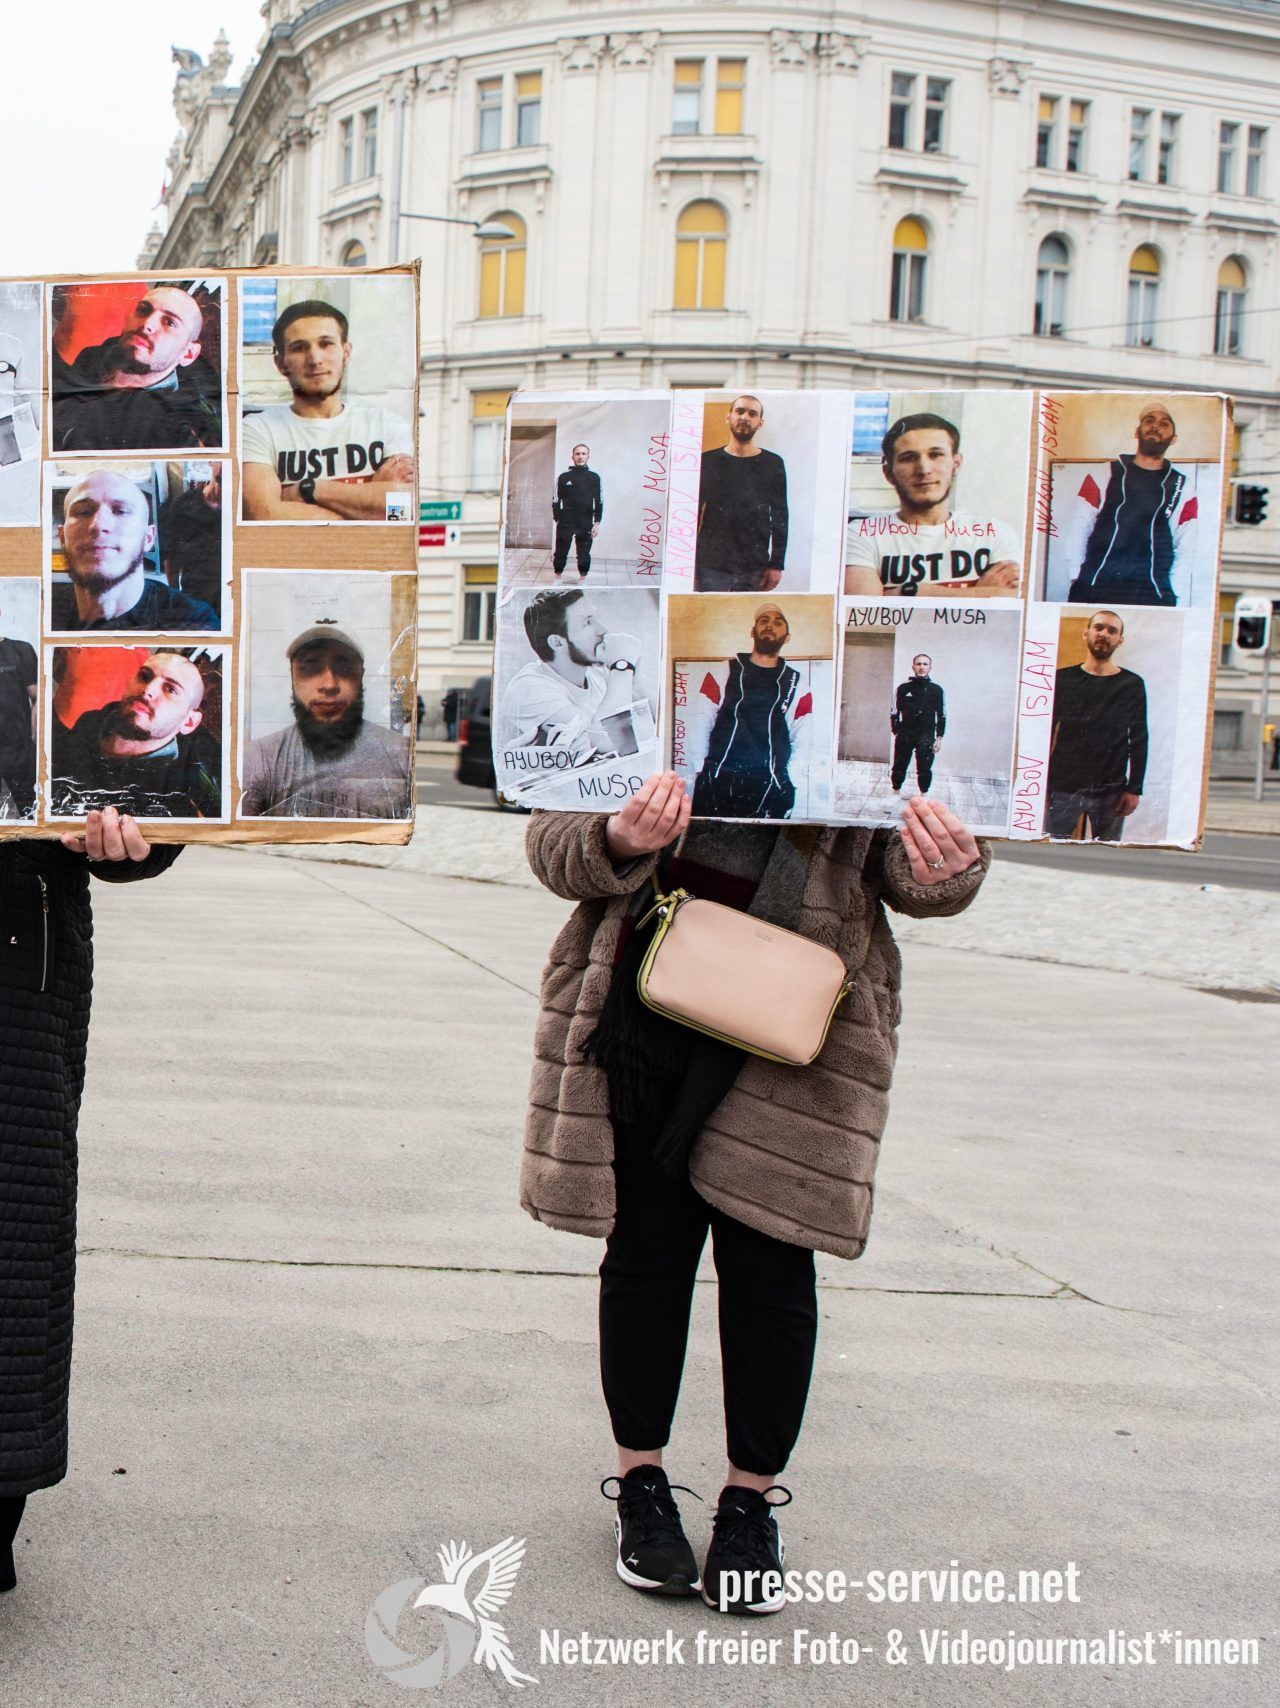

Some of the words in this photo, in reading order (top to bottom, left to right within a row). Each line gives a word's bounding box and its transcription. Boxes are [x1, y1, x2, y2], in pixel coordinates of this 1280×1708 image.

[345, 441, 385, 472] DO
[671, 402, 703, 472] ISLAM
[1039, 395, 1064, 457] ISLAM
[642, 432, 670, 492] MUSA
[636, 508, 662, 576] AYUBOV
[664, 487, 698, 578] AYUBOV
[951, 547, 992, 578] DO
[847, 607, 914, 627] AYUBOV
[934, 608, 986, 625] MUSA
[1020, 639, 1055, 717] ISLAM
[504, 751, 579, 770] AYUBOV
[1012, 754, 1044, 832] AYUBOV
